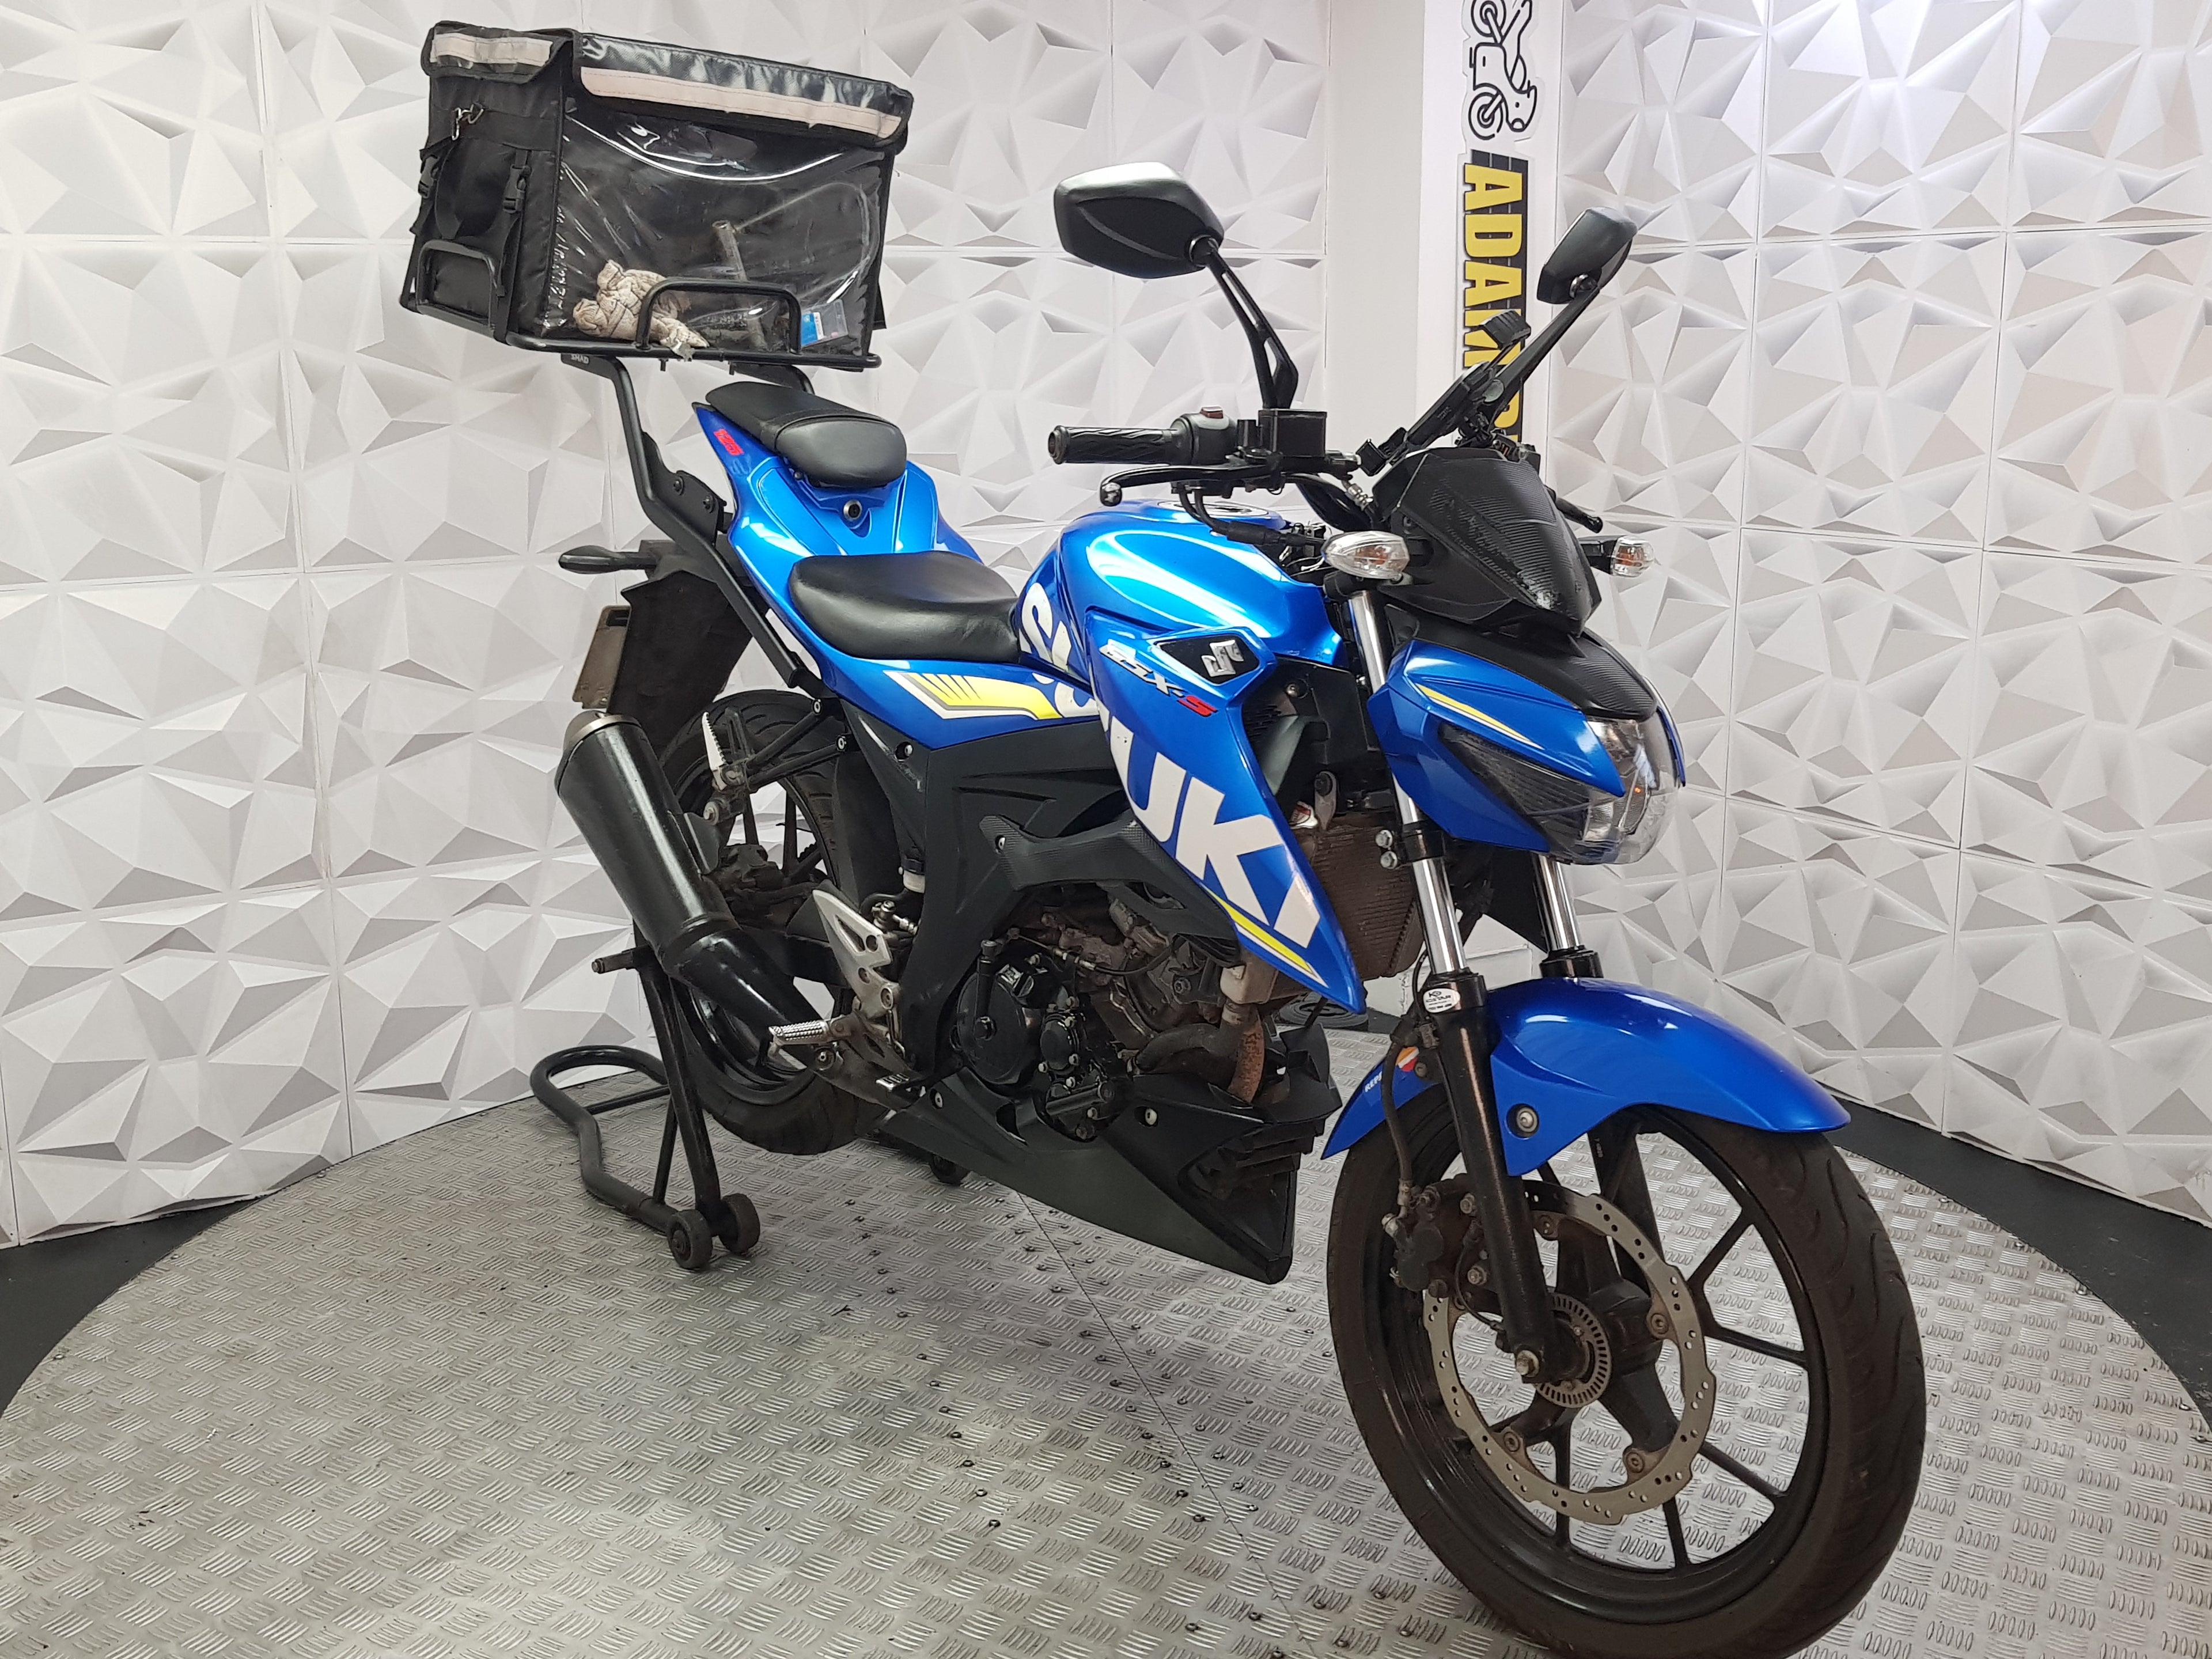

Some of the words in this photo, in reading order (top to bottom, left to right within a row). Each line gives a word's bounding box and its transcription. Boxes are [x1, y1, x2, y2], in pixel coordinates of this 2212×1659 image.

[571, 354, 589, 364] SHAD
[713, 428, 745, 457] 125
[1099, 638, 1218, 718] GSX-S
